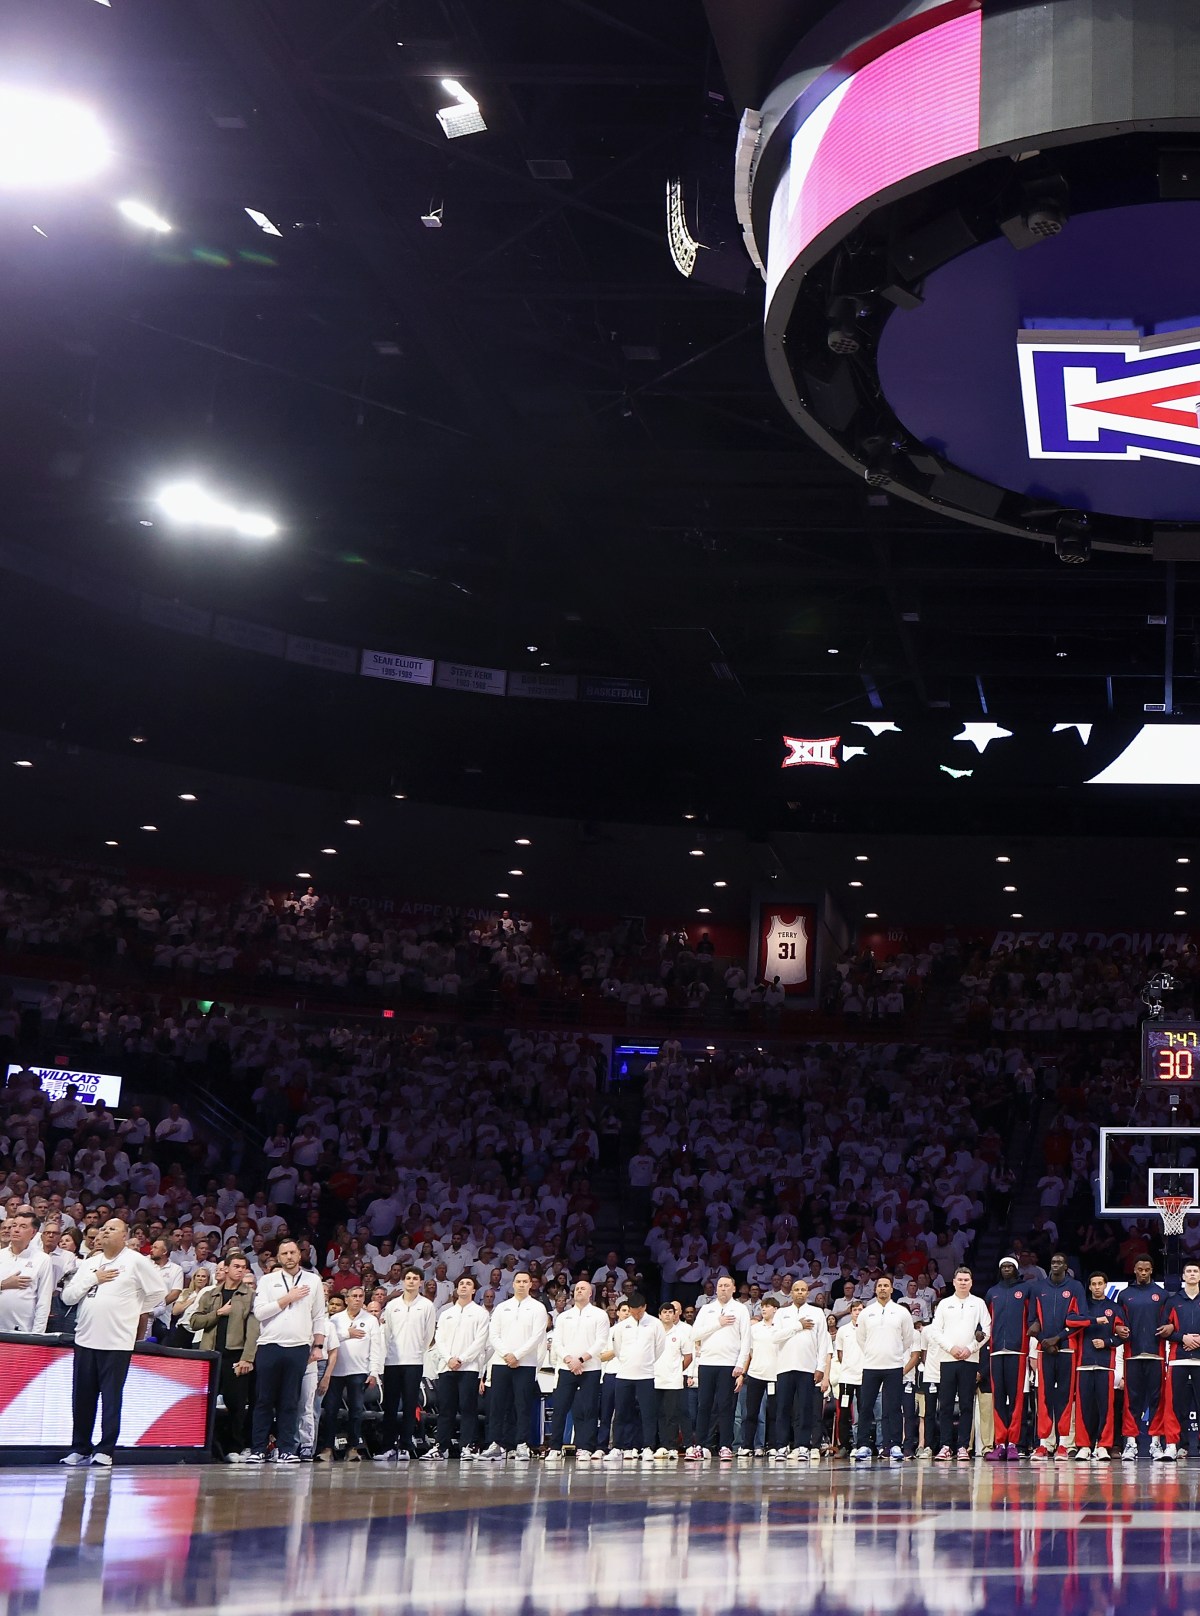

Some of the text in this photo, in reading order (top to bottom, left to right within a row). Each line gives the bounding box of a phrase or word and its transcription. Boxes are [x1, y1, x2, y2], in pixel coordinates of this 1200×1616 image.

[373, 655, 423, 670] SEAN ELLIOTT
[586, 686, 644, 699] BASKETBALL
[778, 942, 796, 960] 31
[1163, 1031, 1197, 1047] 7:47
[1159, 1050, 1192, 1080] 30
[39, 1069, 101, 1085] WILDCATS
[62, 1081, 98, 1093] RDIO
